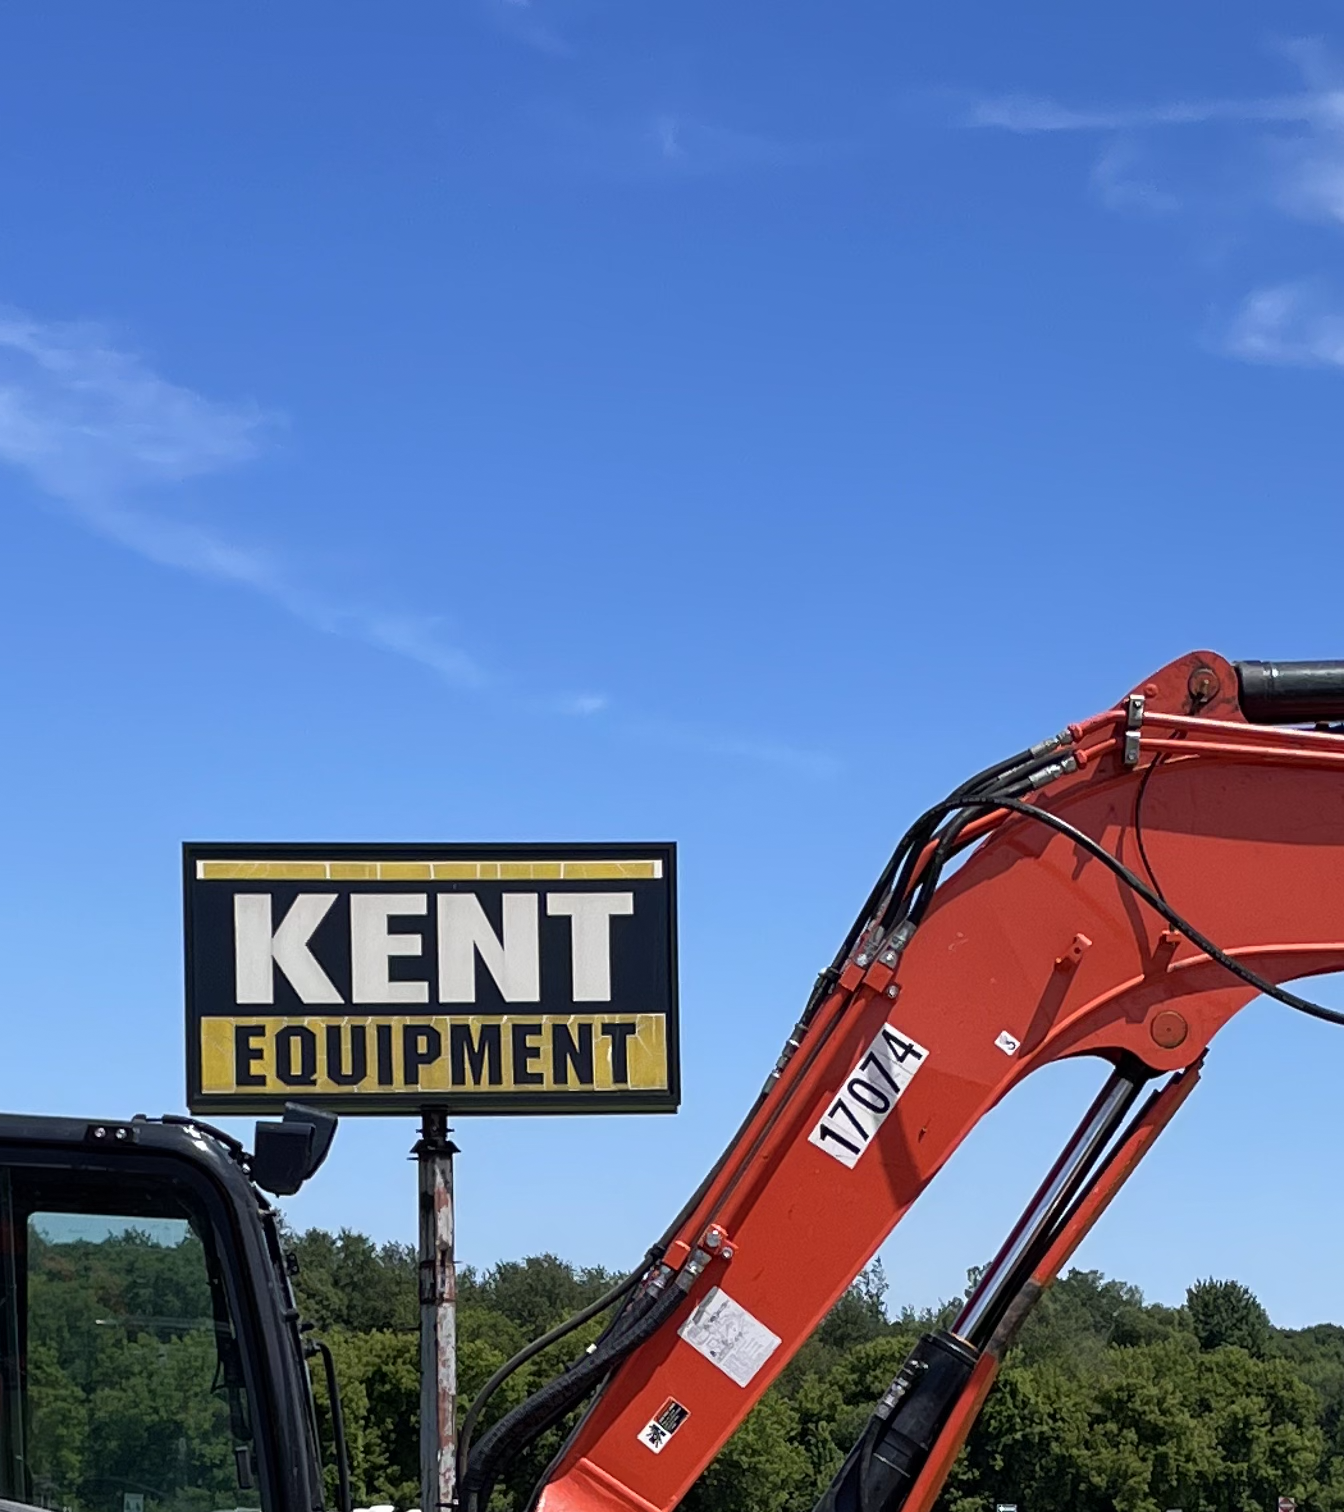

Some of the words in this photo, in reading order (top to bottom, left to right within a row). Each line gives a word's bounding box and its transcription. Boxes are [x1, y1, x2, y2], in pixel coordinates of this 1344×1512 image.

[233, 892, 635, 1005] KENT
[235, 1023, 637, 1087] EQUIPMENT
[819, 1028, 923, 1156] 17074
